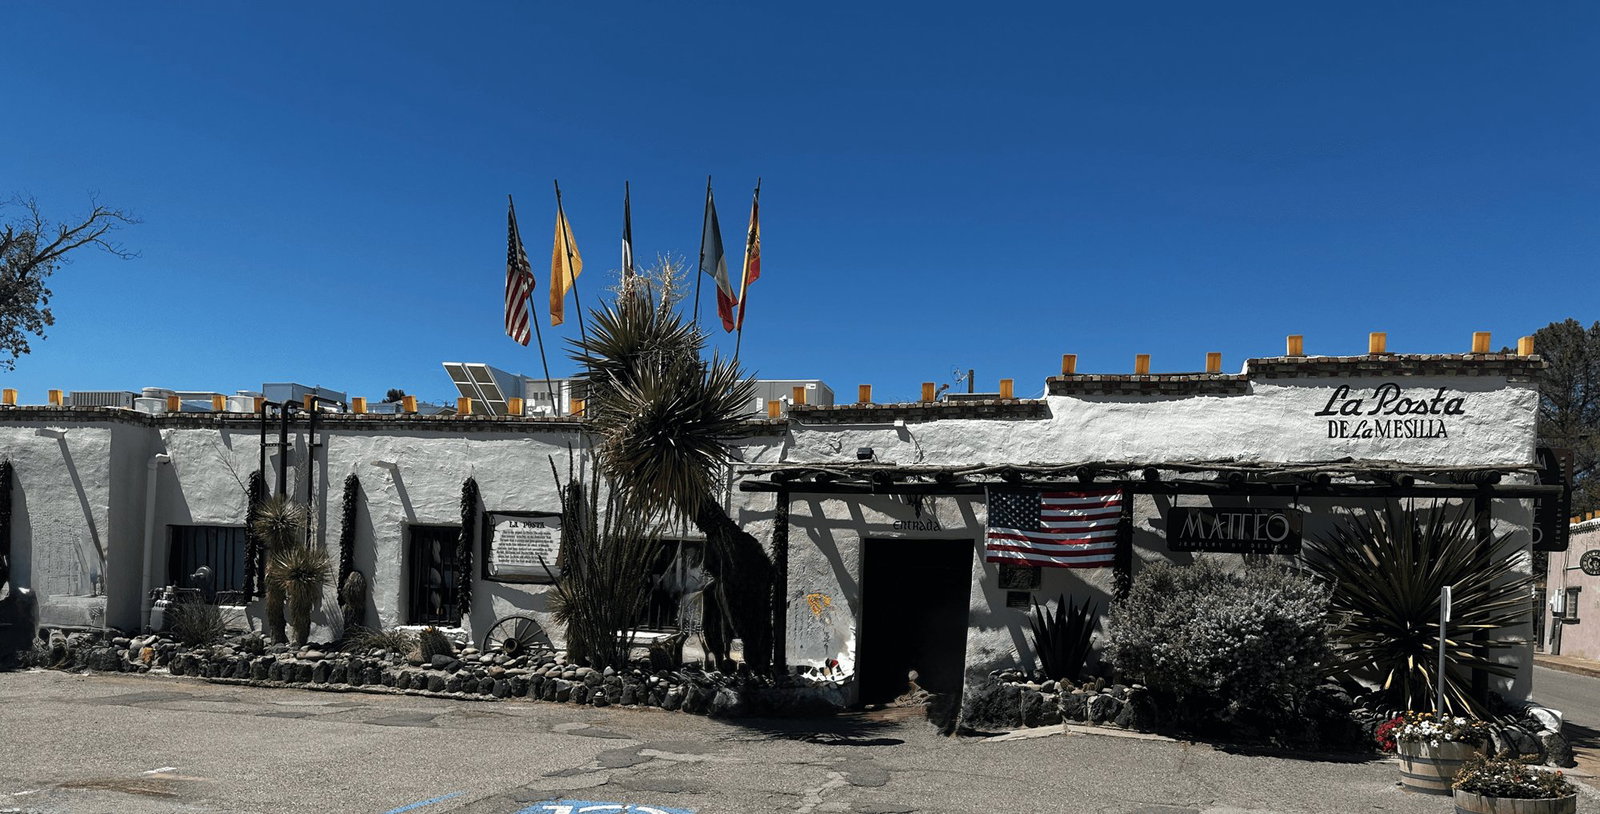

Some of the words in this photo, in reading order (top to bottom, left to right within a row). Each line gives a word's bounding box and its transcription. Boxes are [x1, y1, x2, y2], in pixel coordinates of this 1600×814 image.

[1315, 384, 1363, 416] La
[1368, 382, 1466, 416] Posta
[1328, 419, 1350, 438] DE
[1351, 419, 1373, 438] La
[1374, 418, 1448, 438] MESILLA
[1180, 511, 1290, 542] MATTEO
